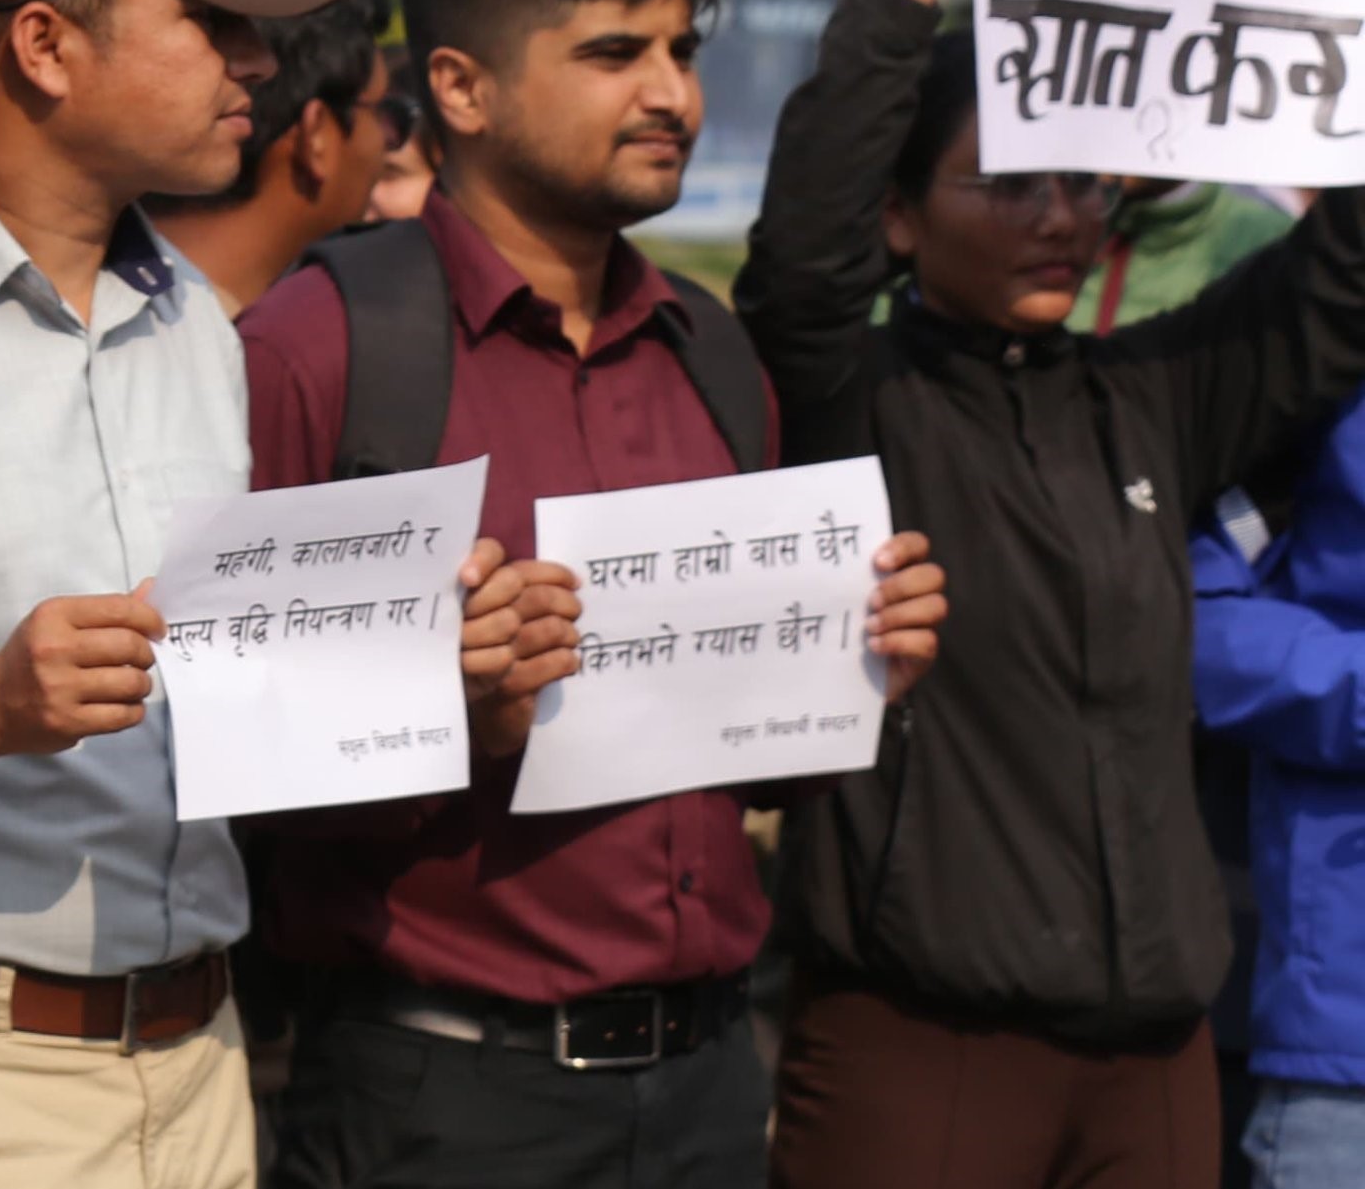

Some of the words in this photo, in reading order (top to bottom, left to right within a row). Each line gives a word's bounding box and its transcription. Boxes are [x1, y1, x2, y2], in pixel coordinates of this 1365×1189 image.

[1171, 1, 1365, 138] कर
[424, 527, 441, 553] र
[586, 551, 659, 589] घरमा
[673, 530, 734, 581] हाम्रो
[813, 511, 860, 565] छैन
[228, 603, 277, 657] वृद्धि
[285, 598, 378, 636] नियन्त्रण
[387, 597, 421, 624] गर
[579, 624, 680, 675] किनभने
[693, 623, 764, 655] ग्यास
[776, 602, 827, 653] छैन
